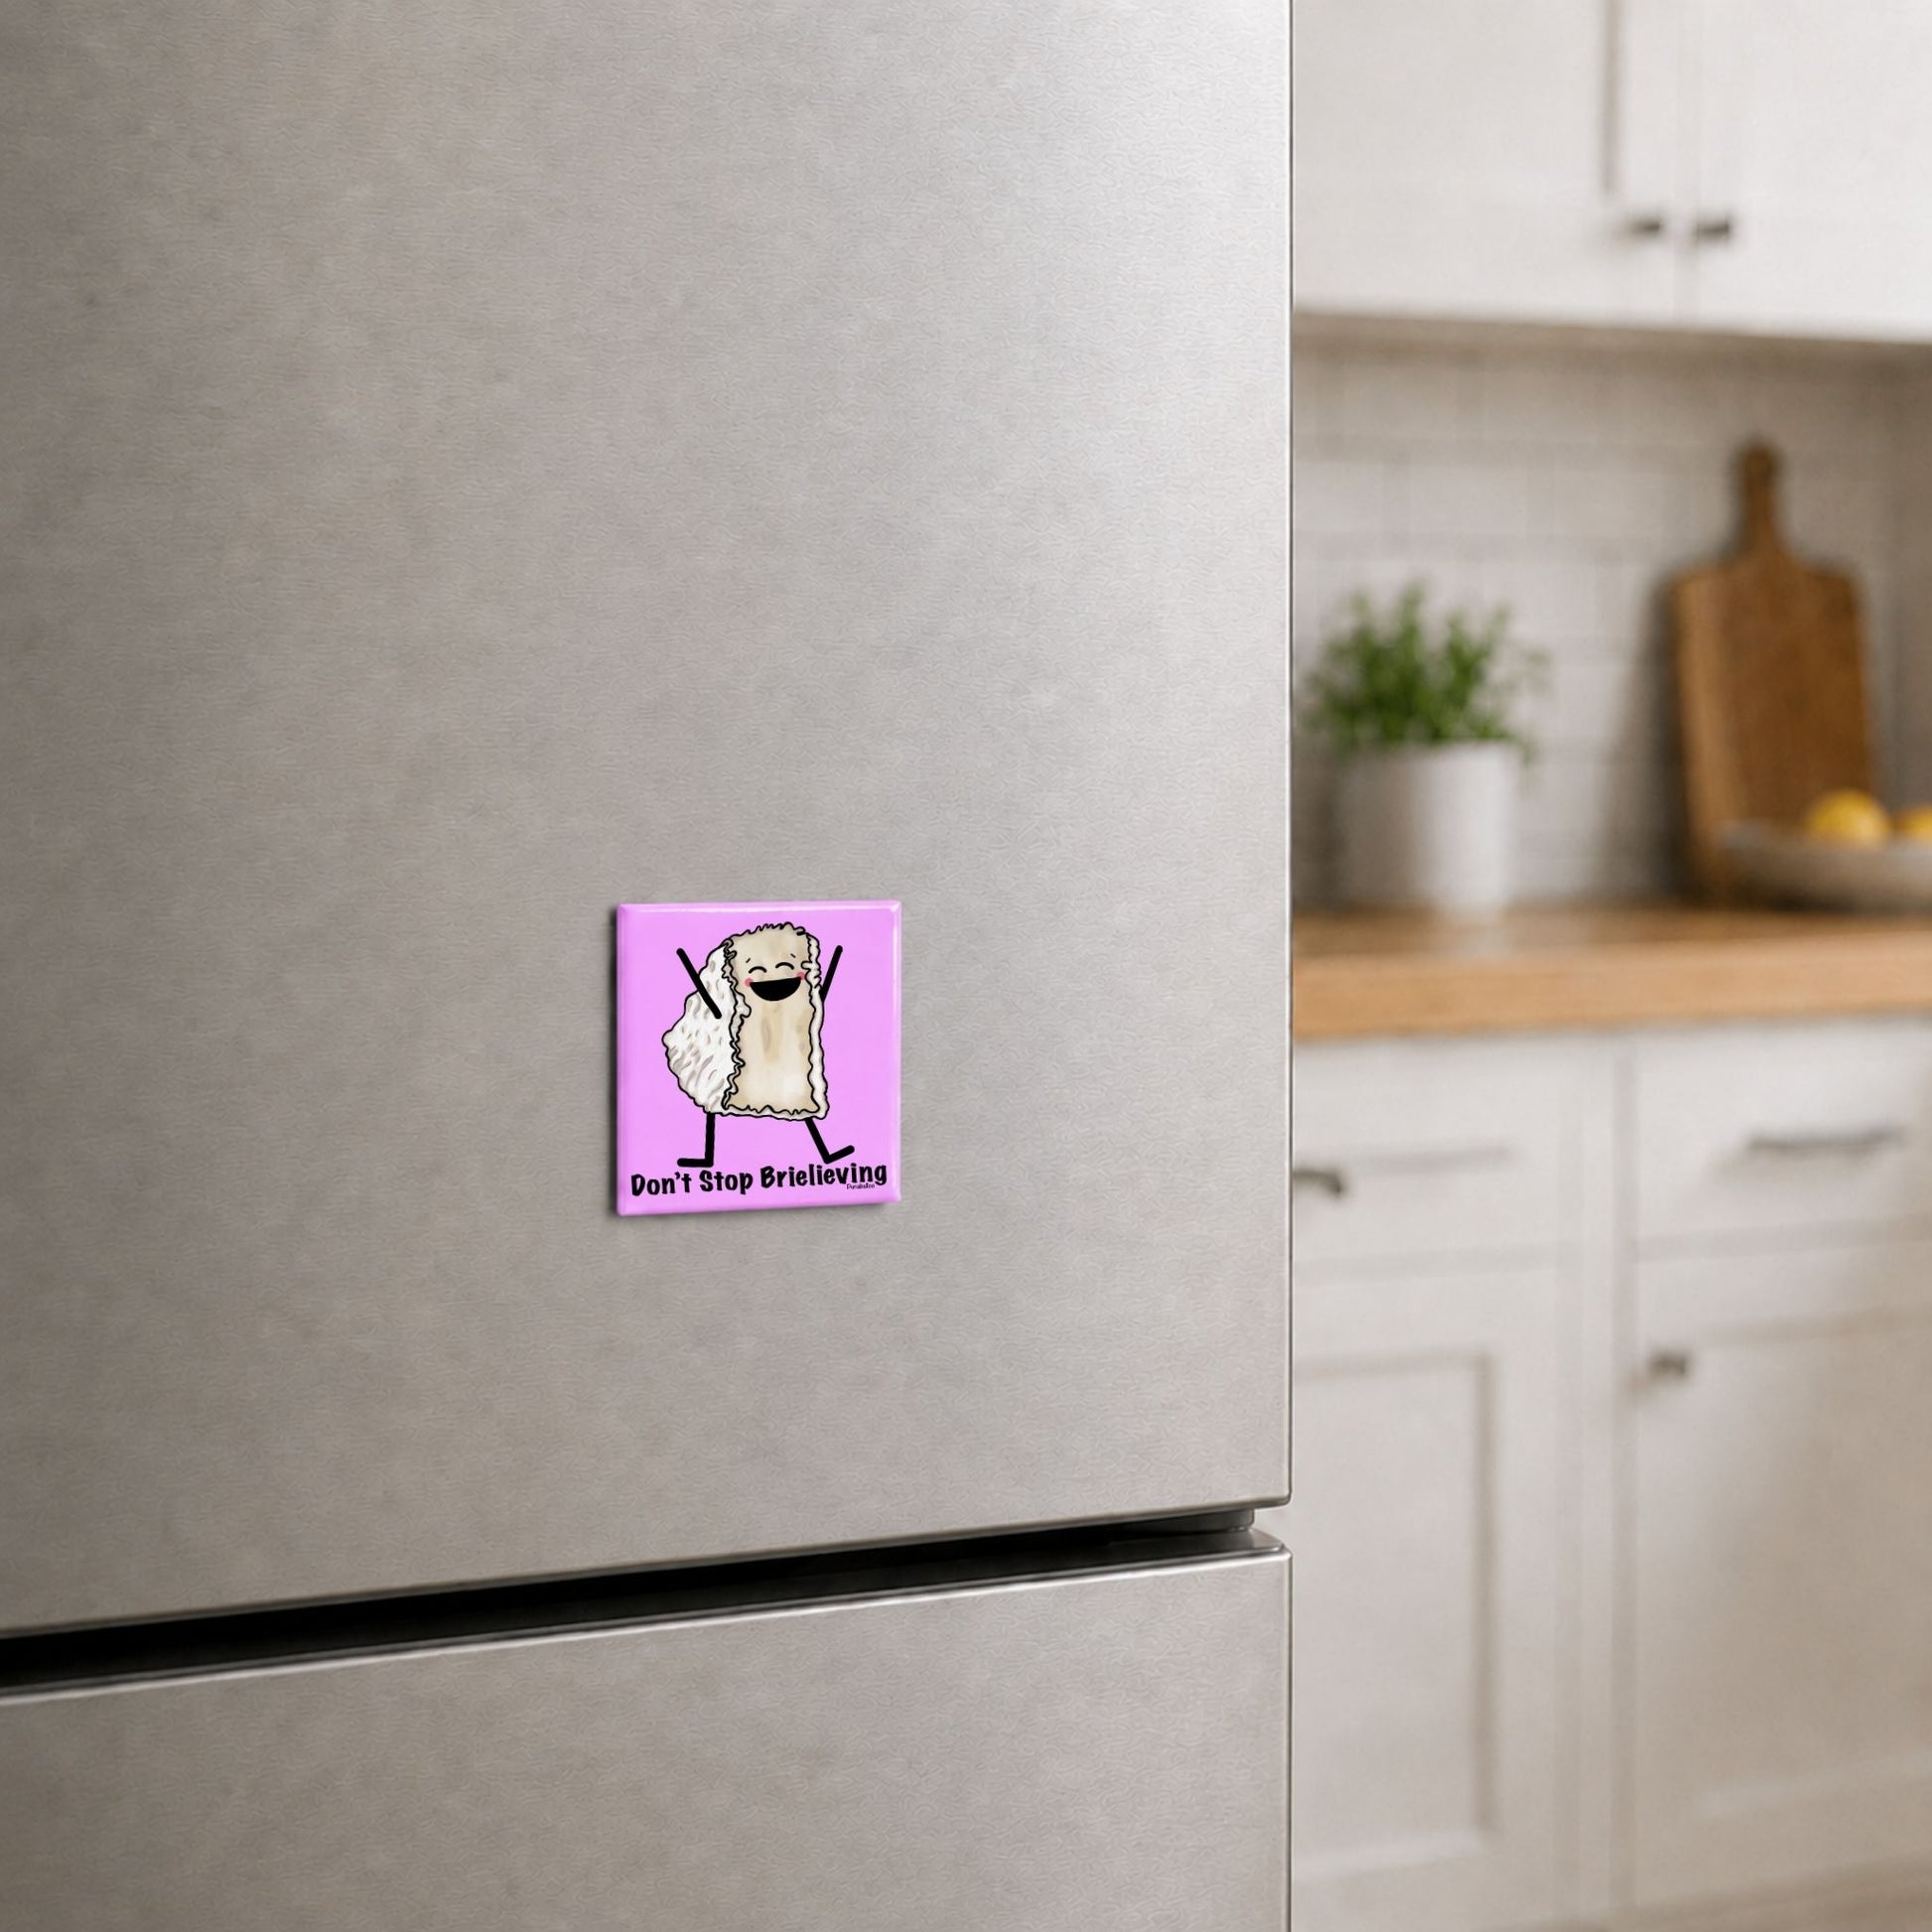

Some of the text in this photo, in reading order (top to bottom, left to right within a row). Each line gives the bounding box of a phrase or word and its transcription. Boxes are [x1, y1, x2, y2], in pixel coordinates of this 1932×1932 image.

[631, 1164, 888, 1196] Don't Stop Brielieving
